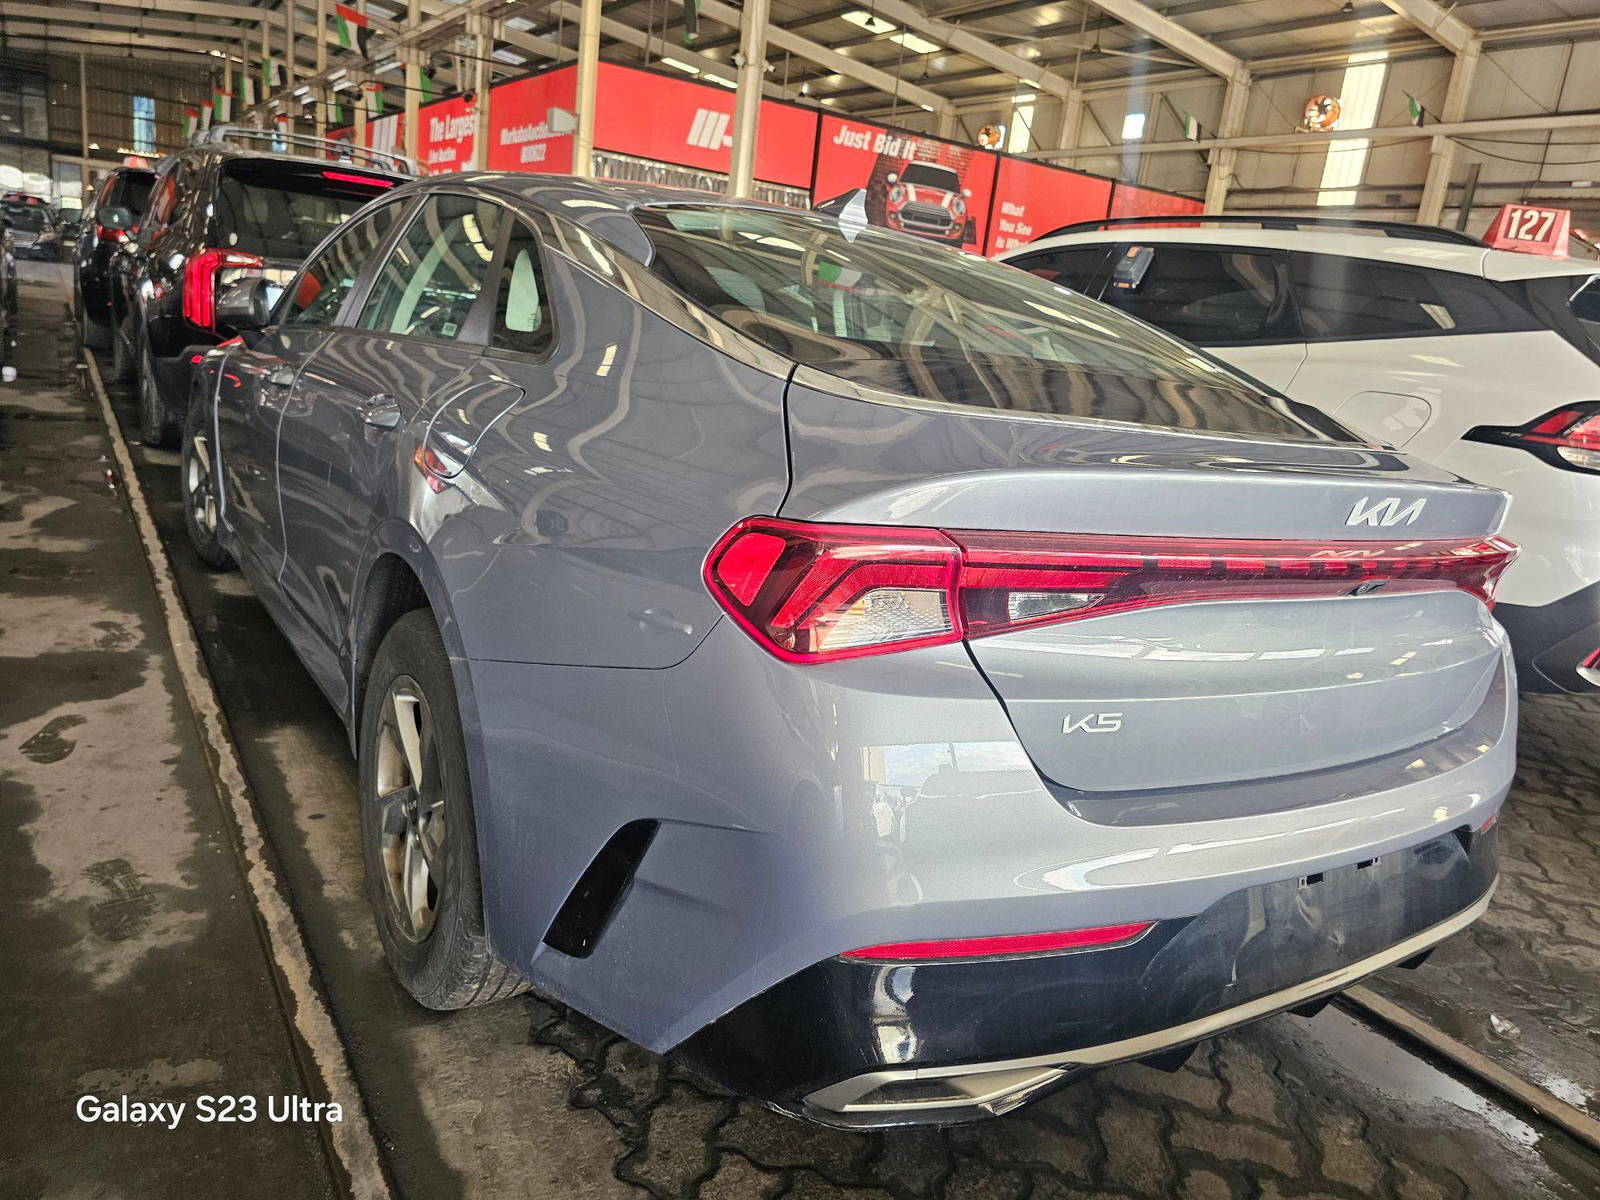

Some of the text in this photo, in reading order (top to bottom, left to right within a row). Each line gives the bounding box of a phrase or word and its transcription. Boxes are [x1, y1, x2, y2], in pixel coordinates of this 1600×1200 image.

[429, 117, 444, 143] The
[833, 125, 917, 161] Just Bid It
[1001, 201, 1025, 217] What
[999, 218, 1032, 236] You See
[1507, 207, 1557, 242] 127
[1061, 712, 1123, 734] K5
